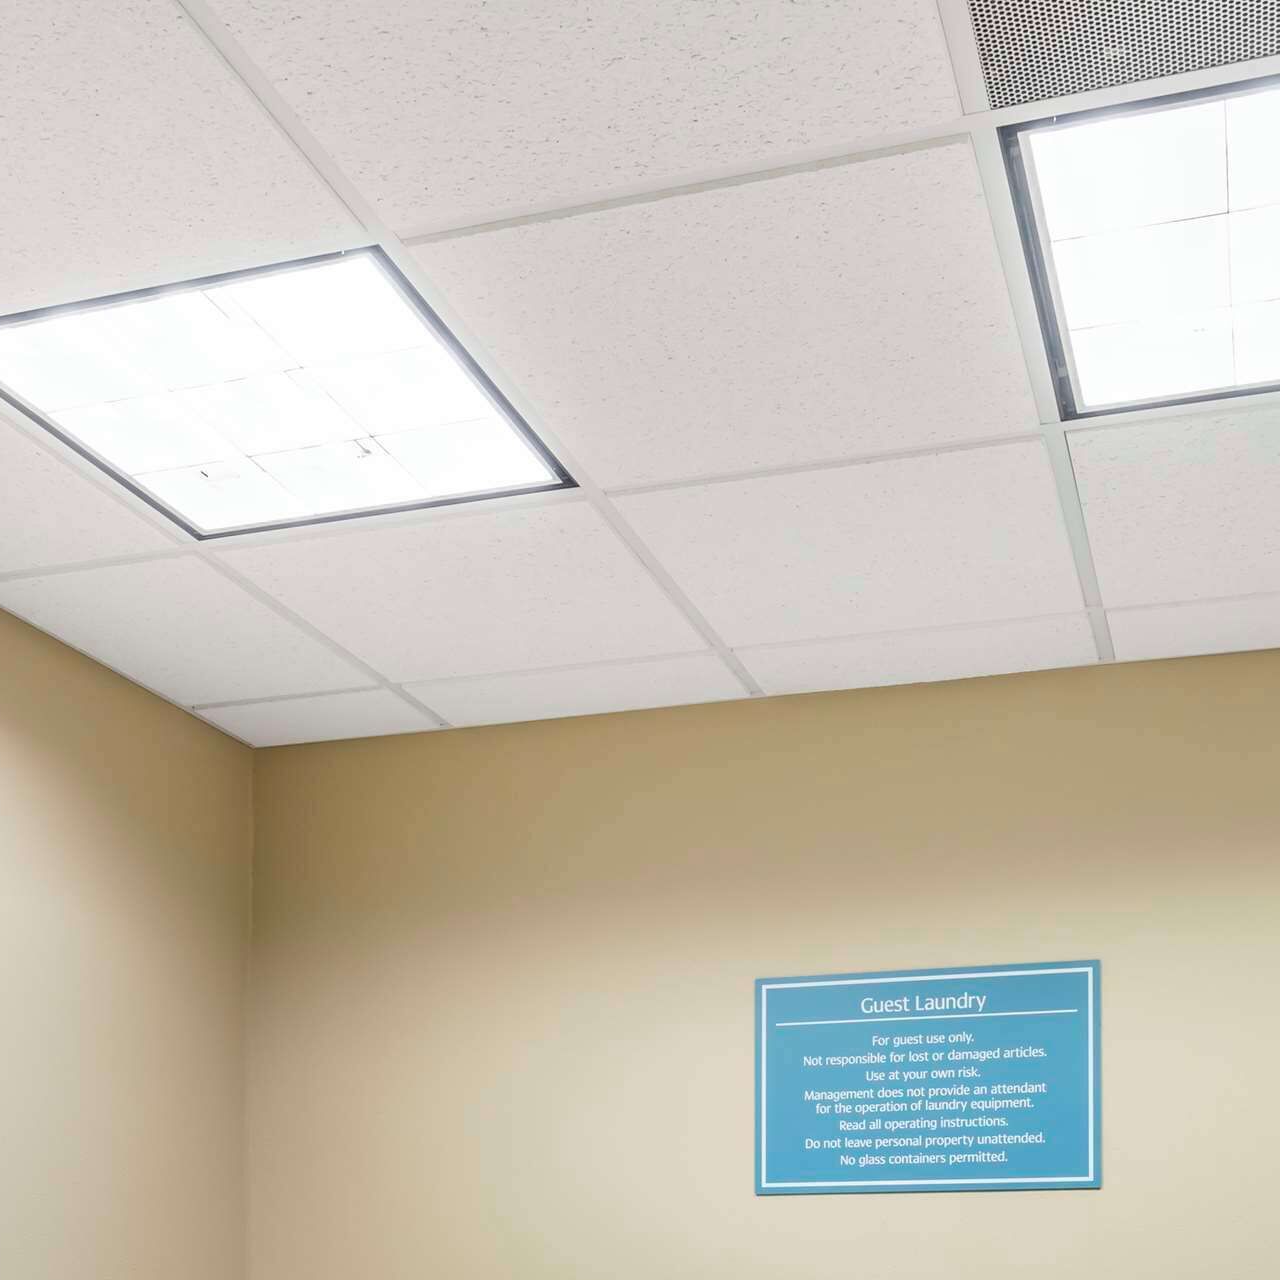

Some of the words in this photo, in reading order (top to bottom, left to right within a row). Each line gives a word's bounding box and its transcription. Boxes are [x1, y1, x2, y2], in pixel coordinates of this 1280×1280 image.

[860, 997, 910, 1014] Guest
[915, 993, 986, 1012] Laundry
[872, 1036, 890, 1046] For
[893, 1035, 922, 1048] guest
[926, 1035, 945, 1044] use
[948, 1032, 974, 1044] only.
[803, 1056, 823, 1067] Not
[825, 1053, 887, 1067] responsible
[890, 1052, 906, 1063] for
[909, 1052, 928, 1062] lost
[932, 1053, 943, 1061] or
[947, 1048, 1000, 1062] damaged
[1003, 1047, 1047, 1058] articles.
[866, 1072, 885, 1081] Use
[888, 1071, 899, 1081] at
[902, 1071, 926, 1082] your
[930, 1070, 955, 1079] own
[958, 1067, 981, 1078] risk.
[804, 1089, 874, 1103] Management
[877, 1088, 904, 1098] does
[906, 1088, 925, 1097] not
[928, 1085, 970, 1098] provide
[973, 1087, 988, 1095] an
[990, 1083, 1046, 1095] attendant
[815, 1104, 830, 1114] for
[835, 1103, 852, 1114] the
[854, 1102, 907, 1116] operation
[910, 1100, 922, 1111] of
[925, 1100, 968, 1112] laundry
[970, 1098, 1034, 1111] equipment.
[839, 1120, 866, 1131] Read
[869, 1119, 881, 1130] all
[884, 1120, 937, 1132] operating
[940, 1116, 1009, 1128] instructions.
[805, 1139, 821, 1149] Do
[823, 1139, 841, 1149] not
[845, 1138, 873, 1148] leave
[875, 1136, 922, 1149] personal
[925, 1136, 974, 1148] property
[977, 1133, 1046, 1145] unattended.
[840, 1156, 856, 1165] No
[858, 1155, 886, 1168] glass
[888, 1155, 946, 1165] containers
[949, 1152, 1008, 1165] permitted.
